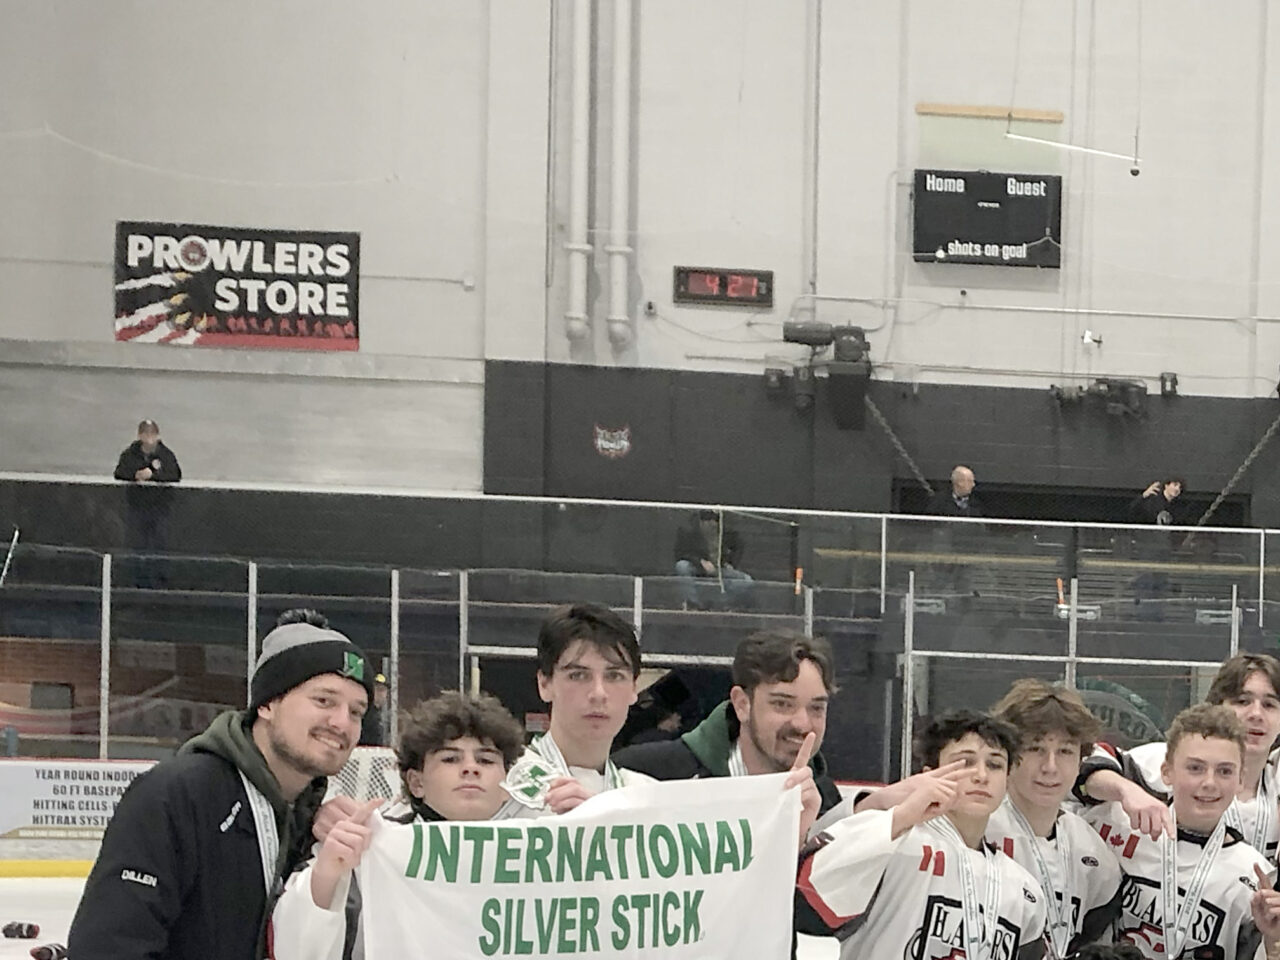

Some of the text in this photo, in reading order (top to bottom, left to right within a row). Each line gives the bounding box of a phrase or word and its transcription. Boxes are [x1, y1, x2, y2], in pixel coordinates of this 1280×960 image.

[926, 174, 1047, 197] Home Guest
[127, 234, 350, 277] PROWLERS
[948, 239, 1028, 260] shots on goal
[214, 278, 350, 316] STORE
[35, 768, 61, 780] YEAR
[64, 770, 100, 781] ROUND
[70, 786, 80, 796] FT
[33, 800, 75, 810] HITTING
[78, 801, 107, 811] CELLS
[33, 815, 77, 825] HITTRAX
[406, 819, 754, 884] INTERNATIONAL
[480, 890, 704, 957] SILVER STICK
